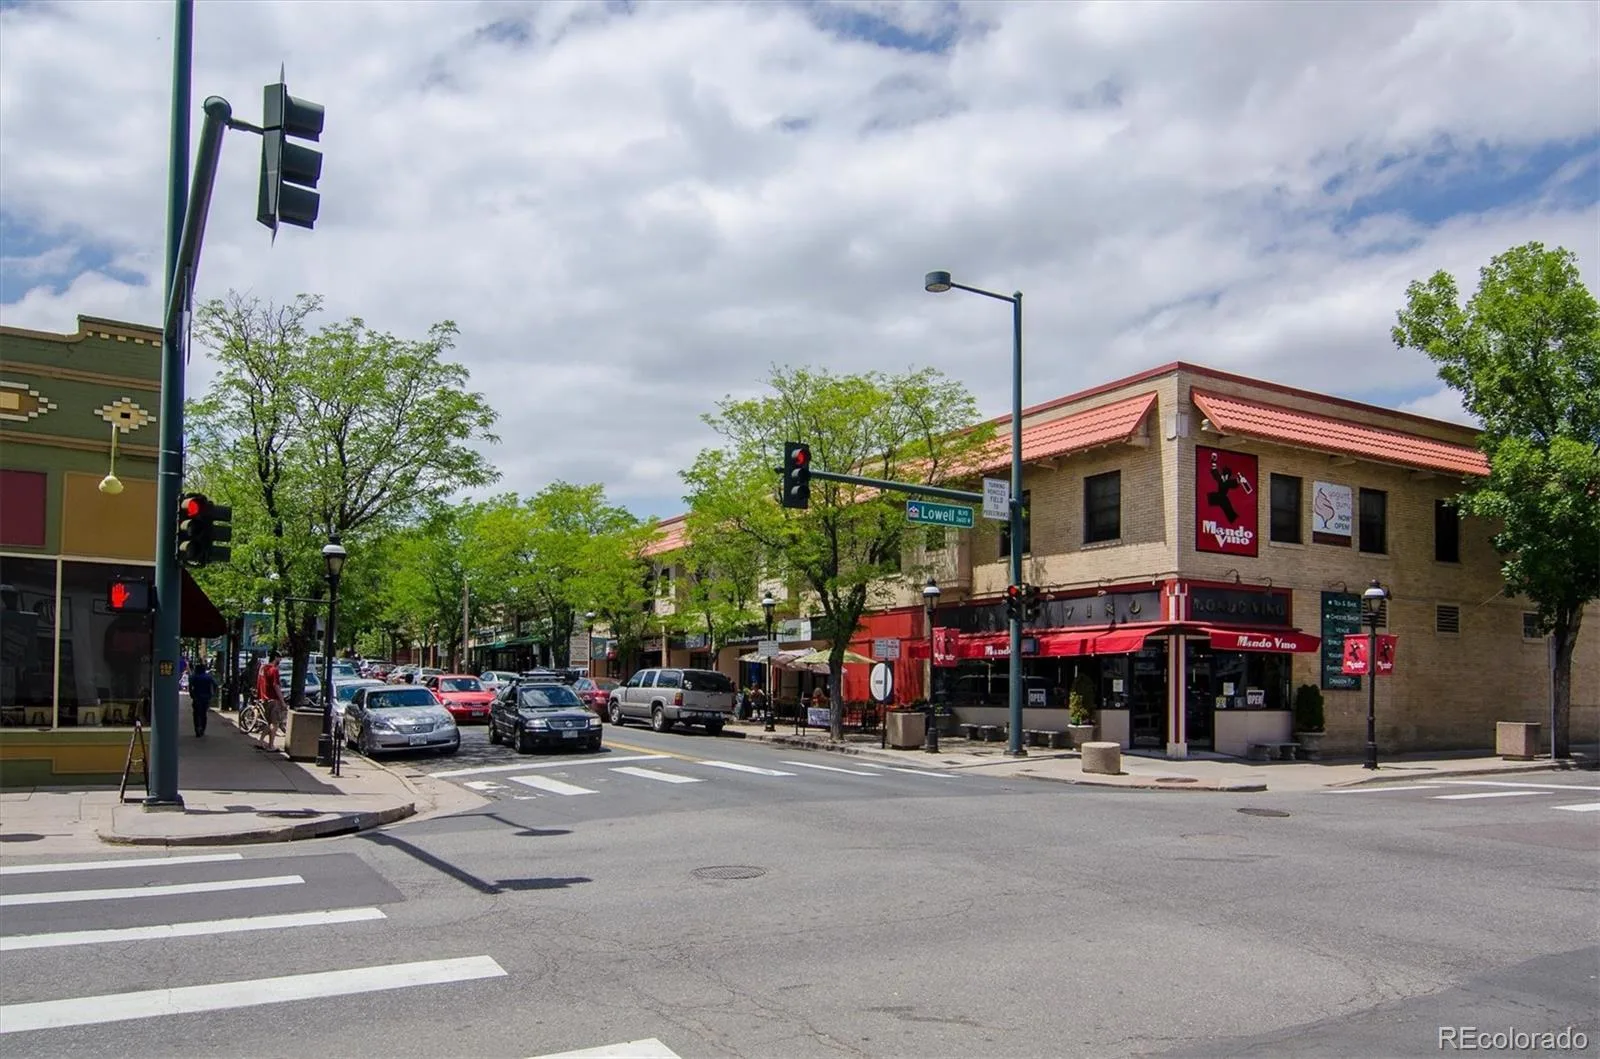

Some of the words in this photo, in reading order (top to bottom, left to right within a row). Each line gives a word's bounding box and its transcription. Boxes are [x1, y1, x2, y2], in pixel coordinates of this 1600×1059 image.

[921, 505, 954, 521] Lowell
[1215, 534, 1250, 548] Vino
[1274, 637, 1297, 650] Vino
